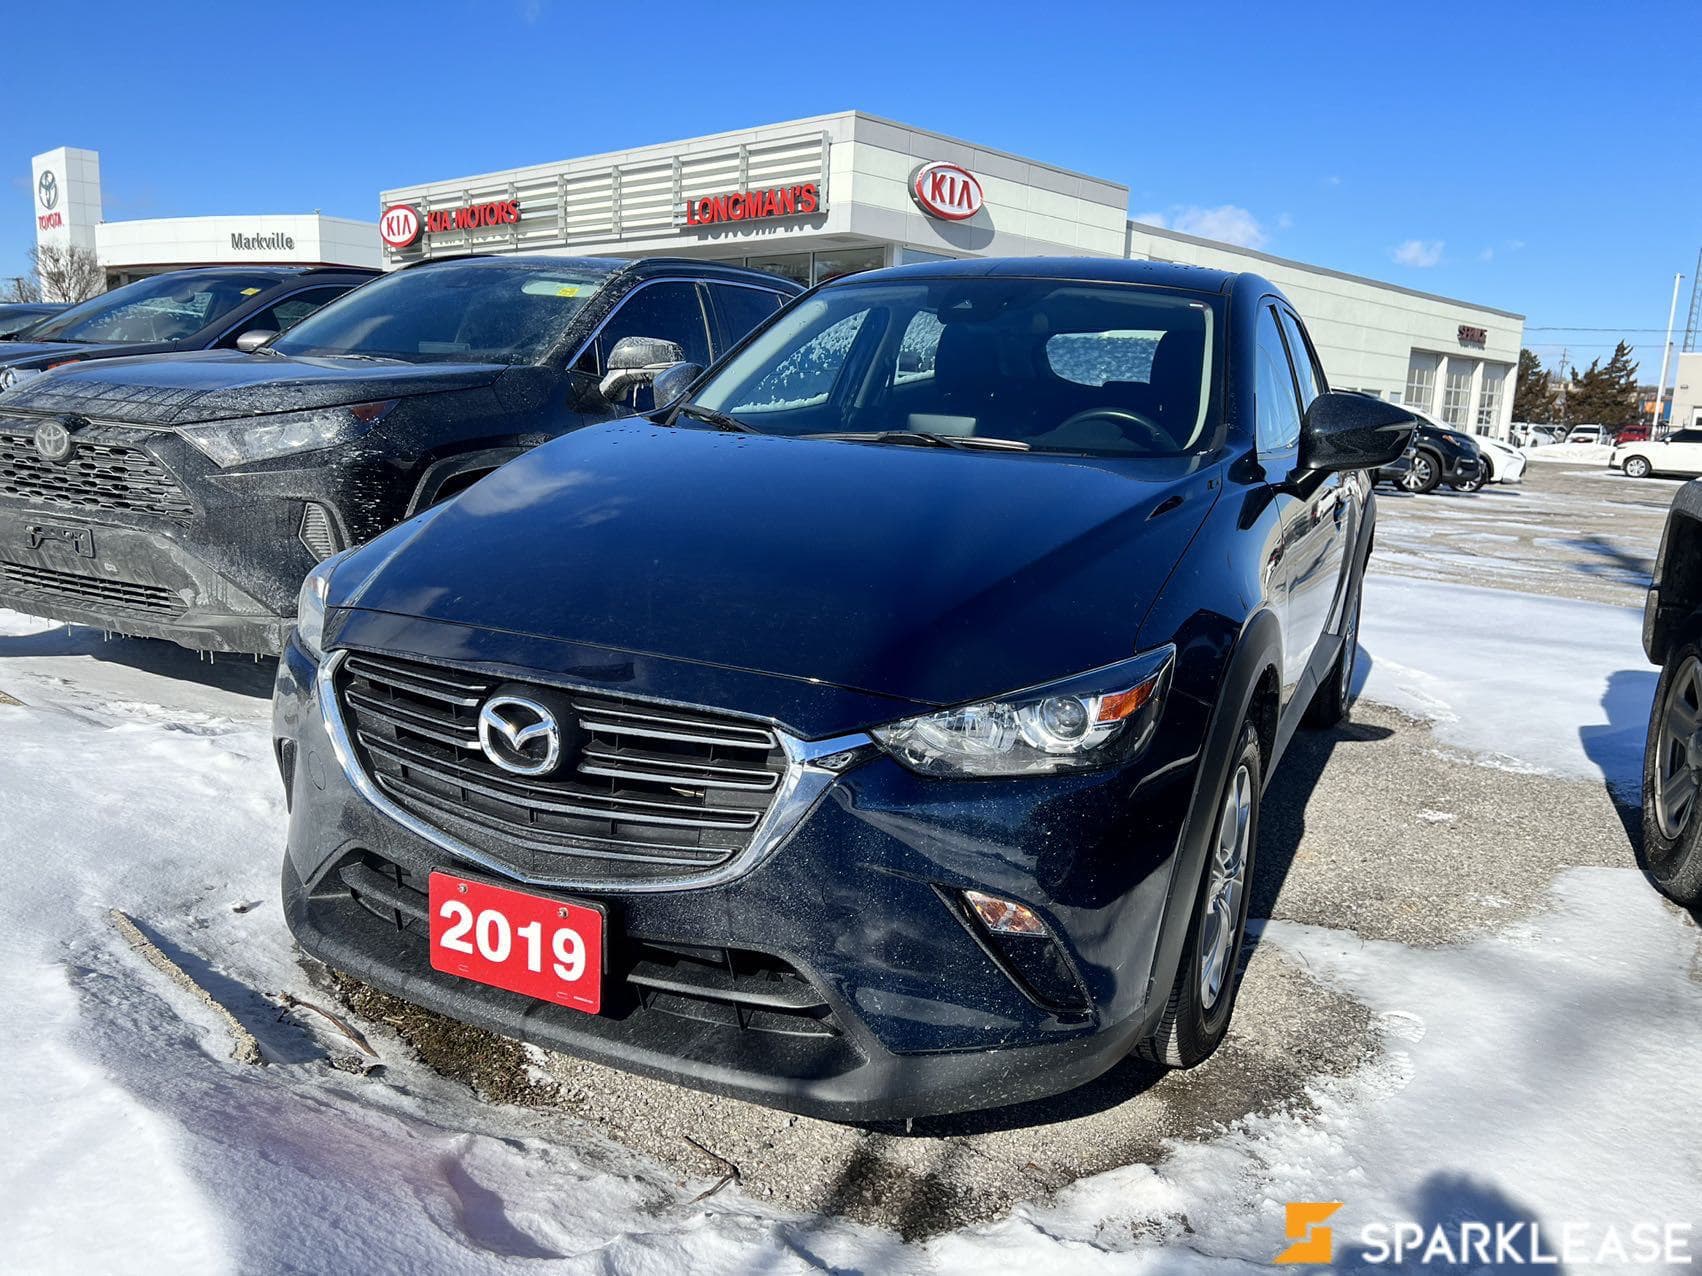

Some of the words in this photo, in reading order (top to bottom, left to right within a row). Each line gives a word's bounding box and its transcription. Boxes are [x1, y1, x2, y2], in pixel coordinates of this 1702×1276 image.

[686, 183, 817, 225] LONGMAN'S
[930, 171, 973, 209] KIA
[38, 212, 62, 231] TOYOTA
[386, 216, 412, 237] KIA
[427, 210, 451, 233] KIA
[455, 201, 519, 229] MOTORS
[231, 232, 295, 250] Markville
[440, 900, 586, 982] 2019
